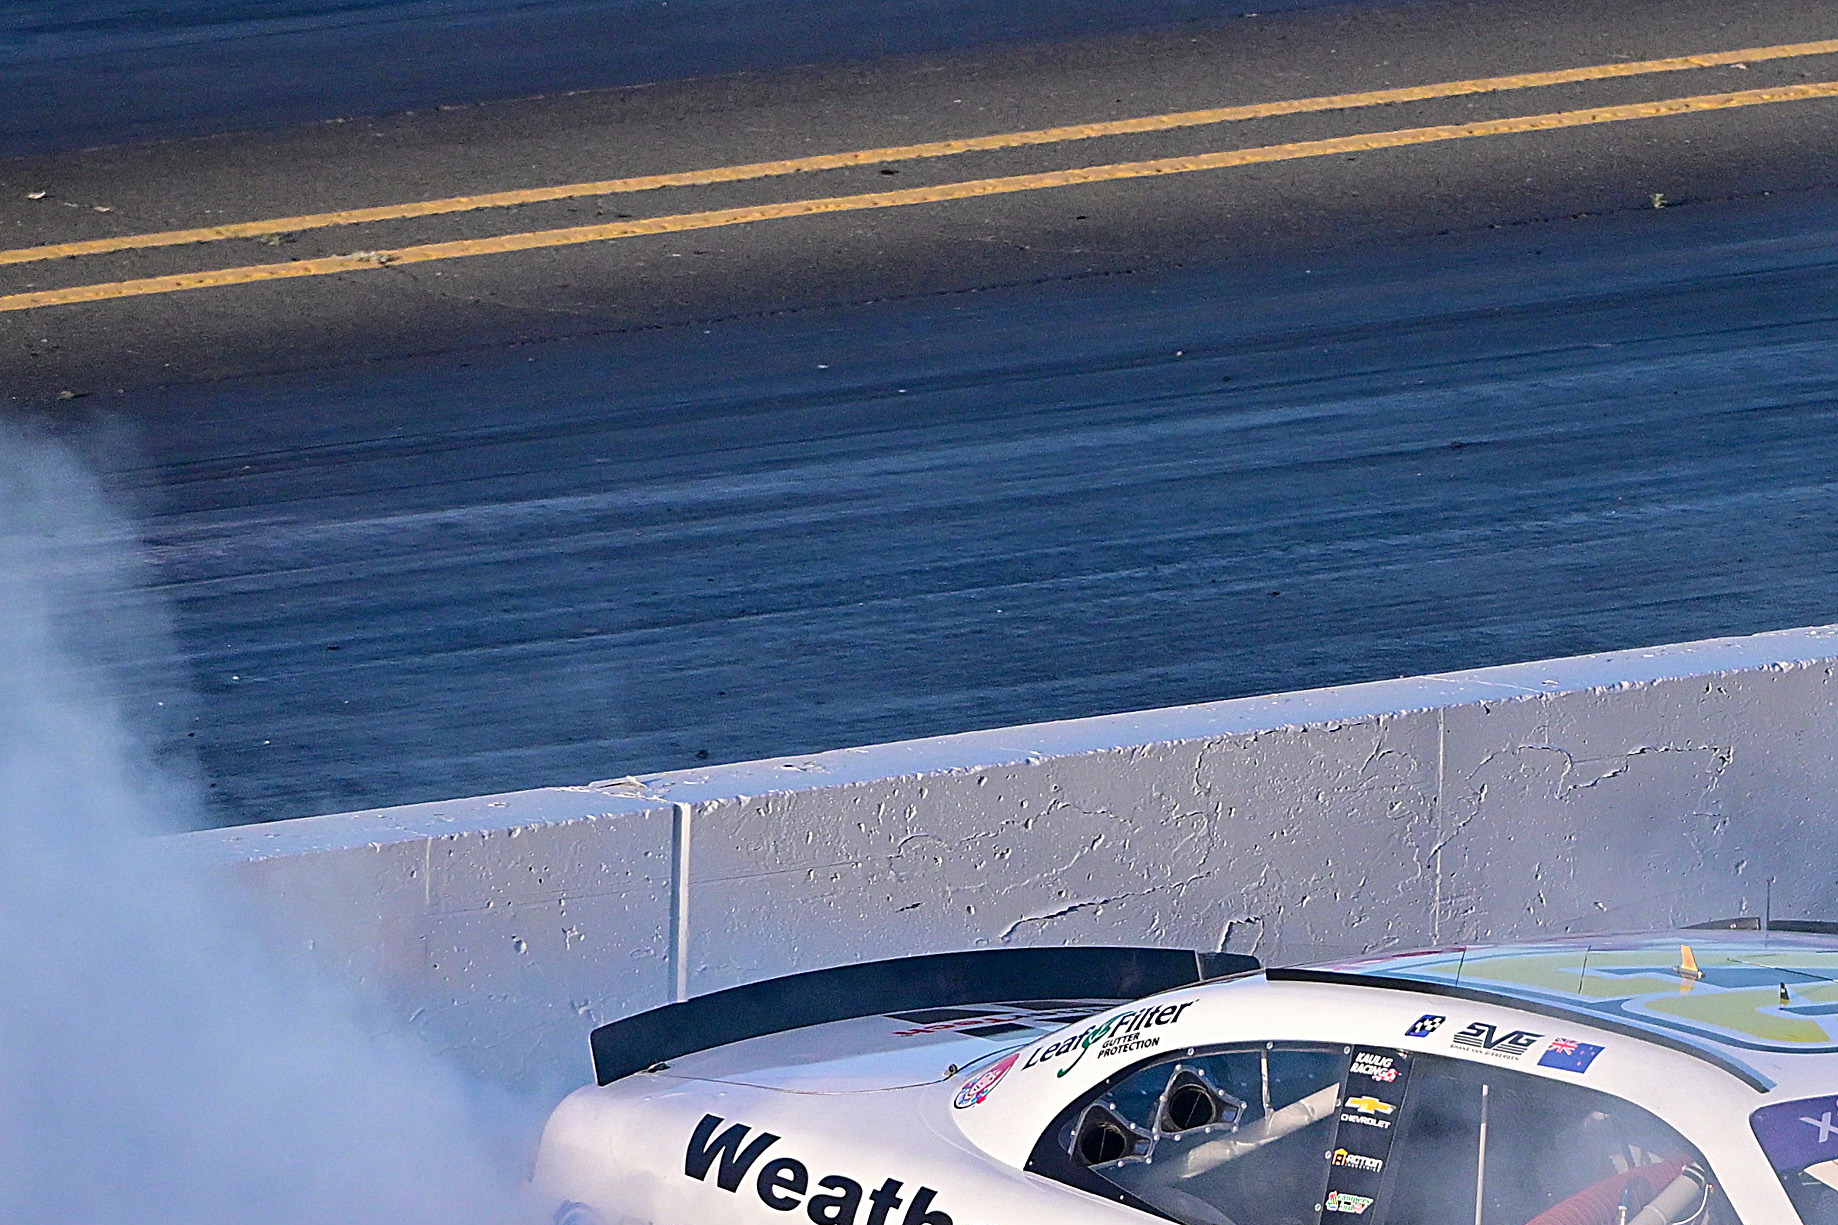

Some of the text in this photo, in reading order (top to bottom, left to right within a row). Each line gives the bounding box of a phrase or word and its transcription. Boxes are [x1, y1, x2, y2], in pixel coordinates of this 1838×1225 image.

[1102, 1033, 1140, 1049] GUTTER
[1457, 1022, 1545, 1049] SVG
[1098, 1036, 1160, 1059] PROTECTION
[1355, 1052, 1393, 1067] KAULIG
[1350, 1062, 1388, 1077] RACING
[1341, 1113, 1391, 1129] CHEVROLET
